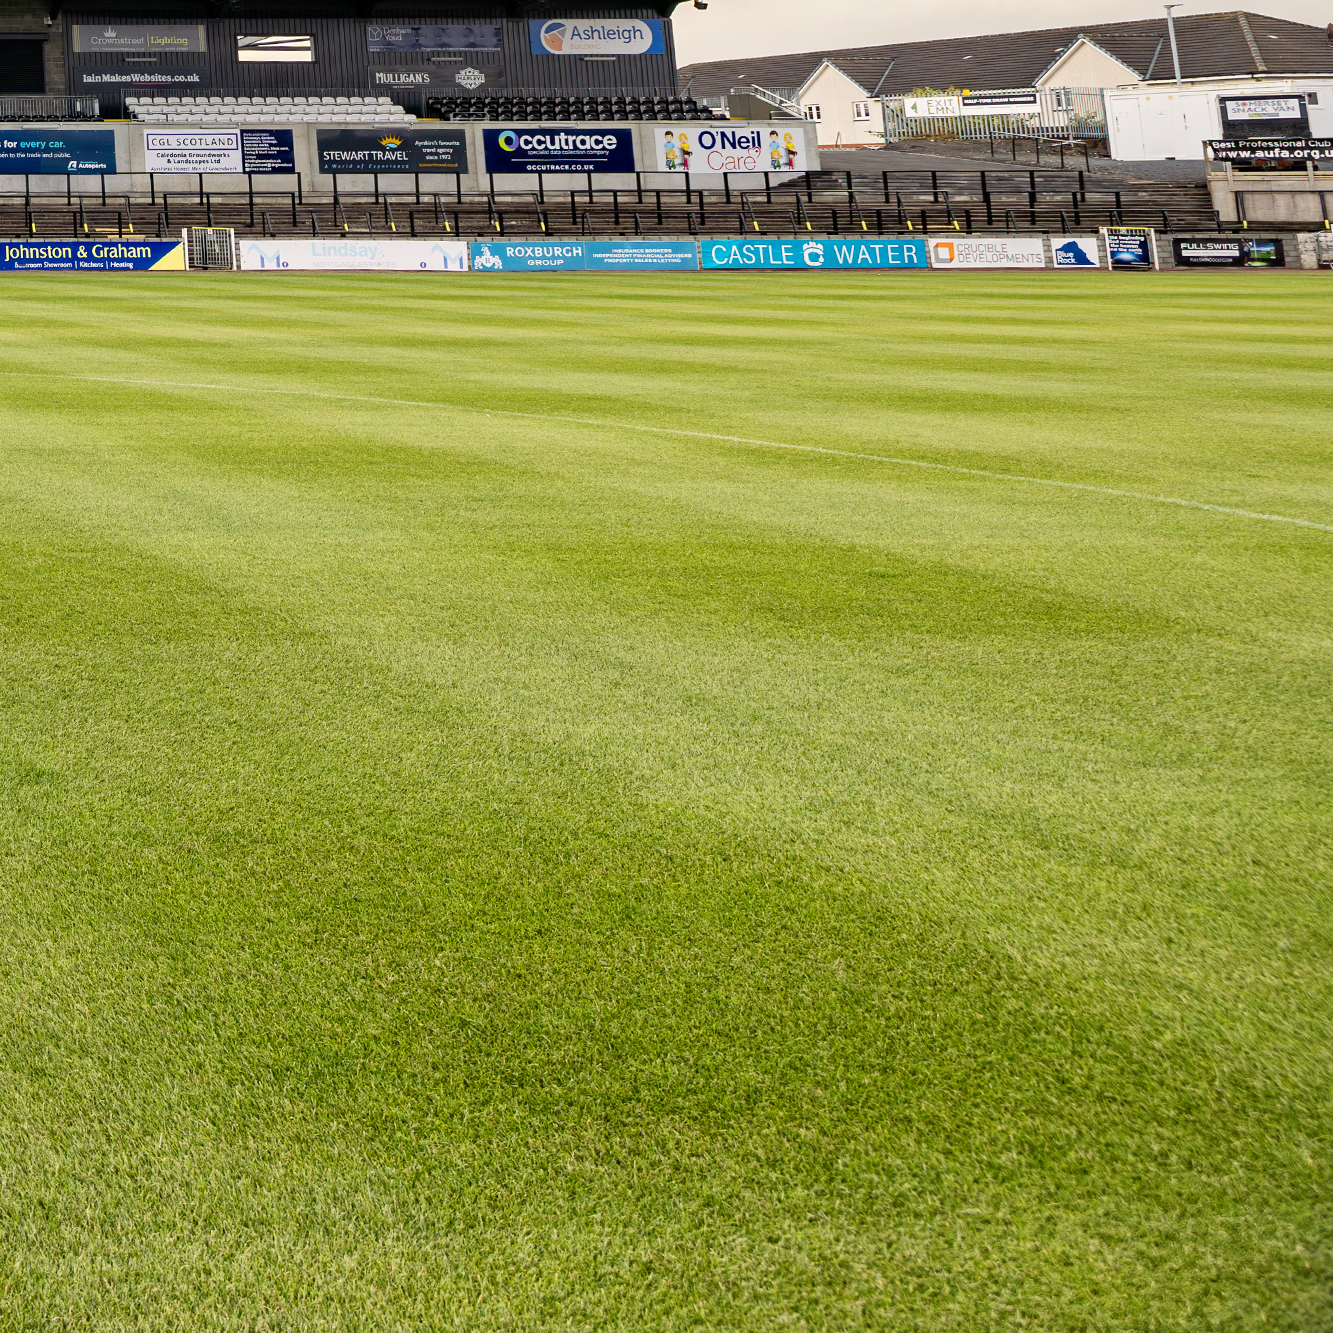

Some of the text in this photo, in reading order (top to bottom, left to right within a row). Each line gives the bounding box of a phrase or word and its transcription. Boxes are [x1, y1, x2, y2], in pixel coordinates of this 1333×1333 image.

[570, 25, 645, 44] Ashleigh
[90, 36, 188, 46] Crownstreet Lighting
[926, 99, 954, 107] EXIT
[1231, 106, 1267, 114] SNACK
[151, 138, 234, 147] CGL SCOTLAND
[697, 130, 762, 150] O'Neil
[1212, 141, 1236, 149] Best
[1308, 139, 1331, 147] Club
[3, 139, 18, 149] for
[19, 141, 47, 152] every
[48, 141, 66, 149] car.
[323, 151, 408, 161] STEWART TRAVEL
[706, 151, 757, 171] Care
[78, 163, 107, 171] Autoparts
[5, 244, 152, 261] Johnston & Graham
[312, 242, 378, 260] Lindsay
[506, 246, 583, 258] ROXBURGH
[957, 243, 1008, 253] CRUCIBLE
[711, 244, 918, 265] CASTLE WATER
[957, 253, 1044, 264] DEVELOPMENTS
[1057, 250, 1075, 259] Blue
